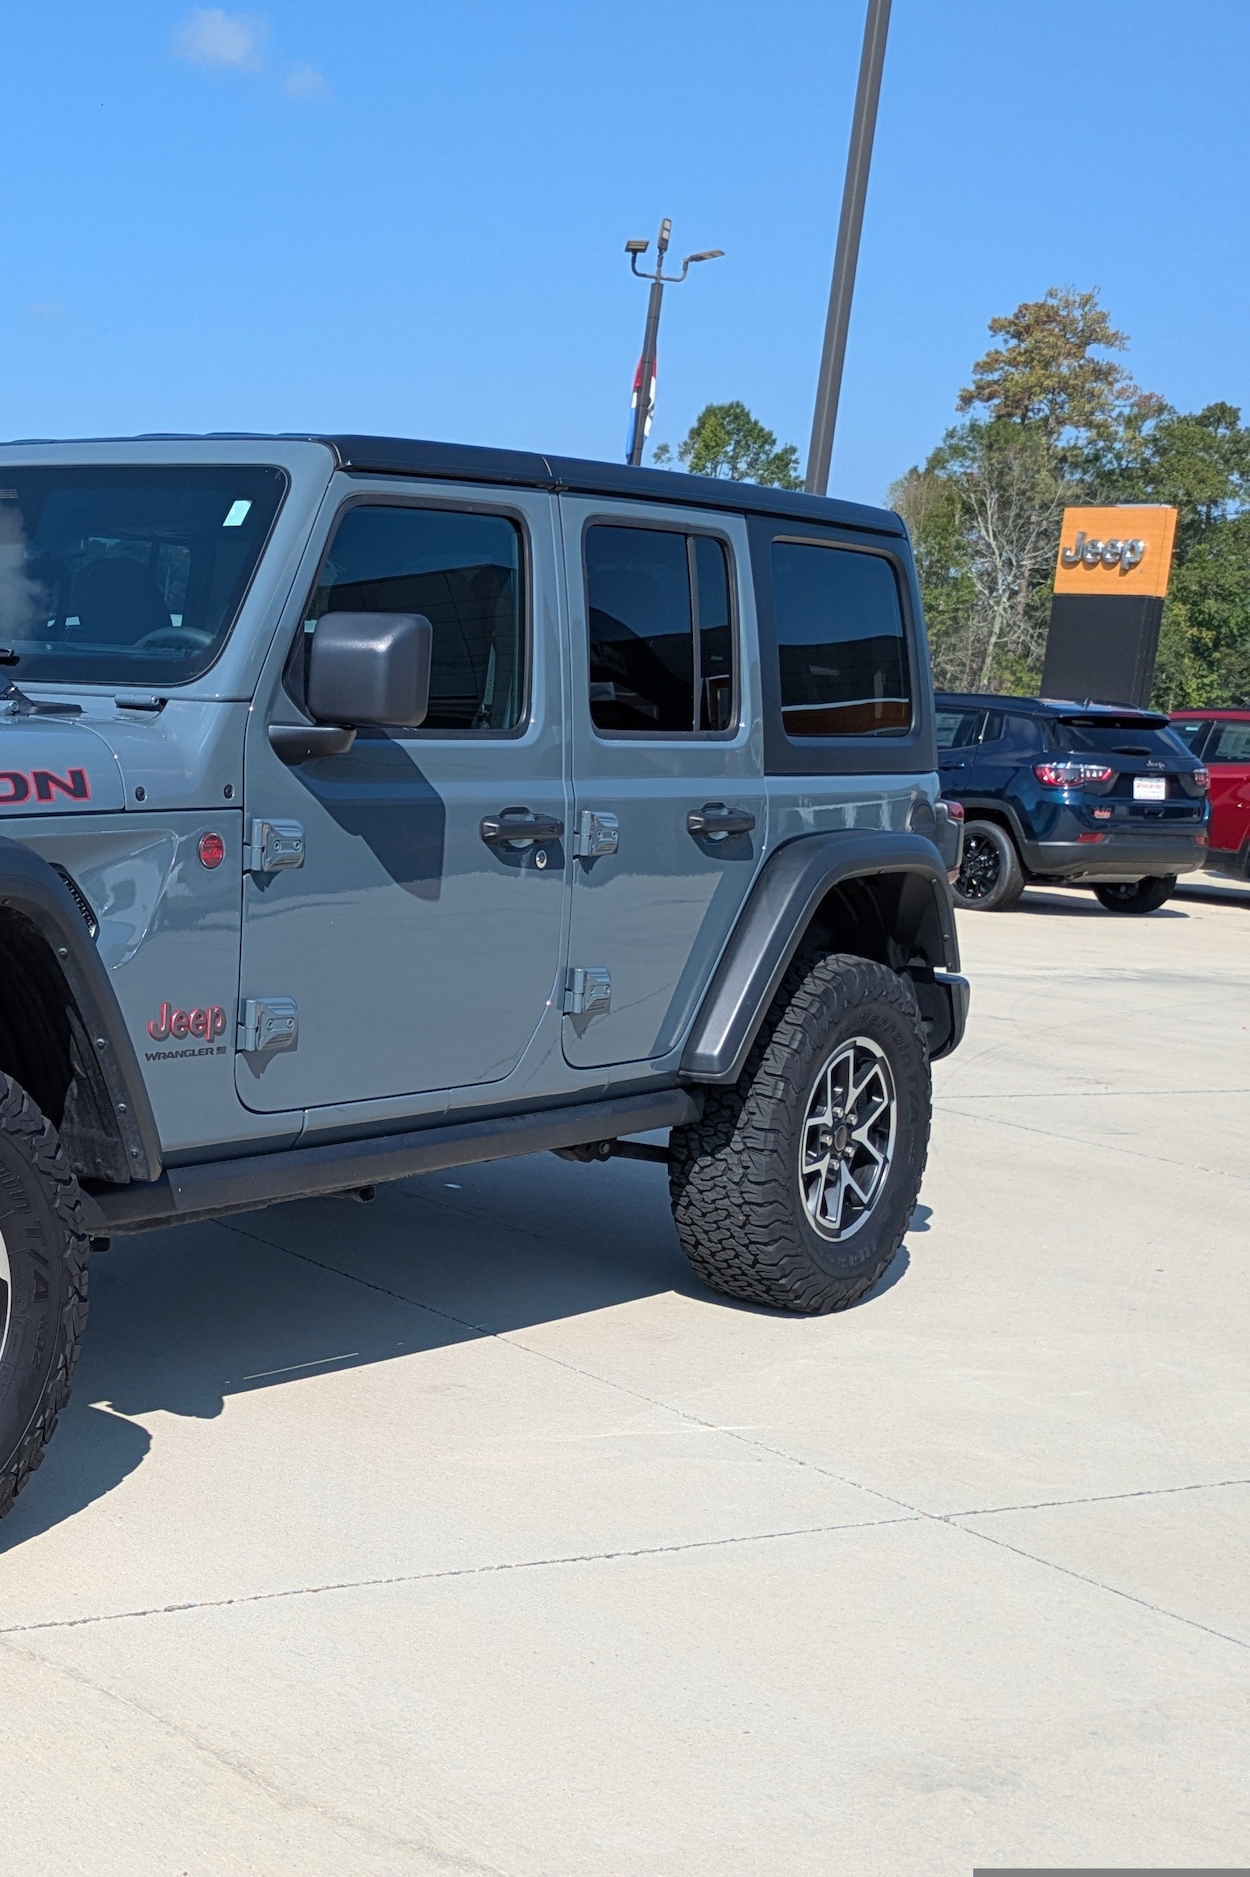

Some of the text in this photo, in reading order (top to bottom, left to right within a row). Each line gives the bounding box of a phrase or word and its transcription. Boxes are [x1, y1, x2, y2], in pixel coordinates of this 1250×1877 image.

[1061, 531, 1146, 571] Jeep
[148, 1002, 227, 1042] Jeep
[145, 1047, 214, 1061] WRANGLER
